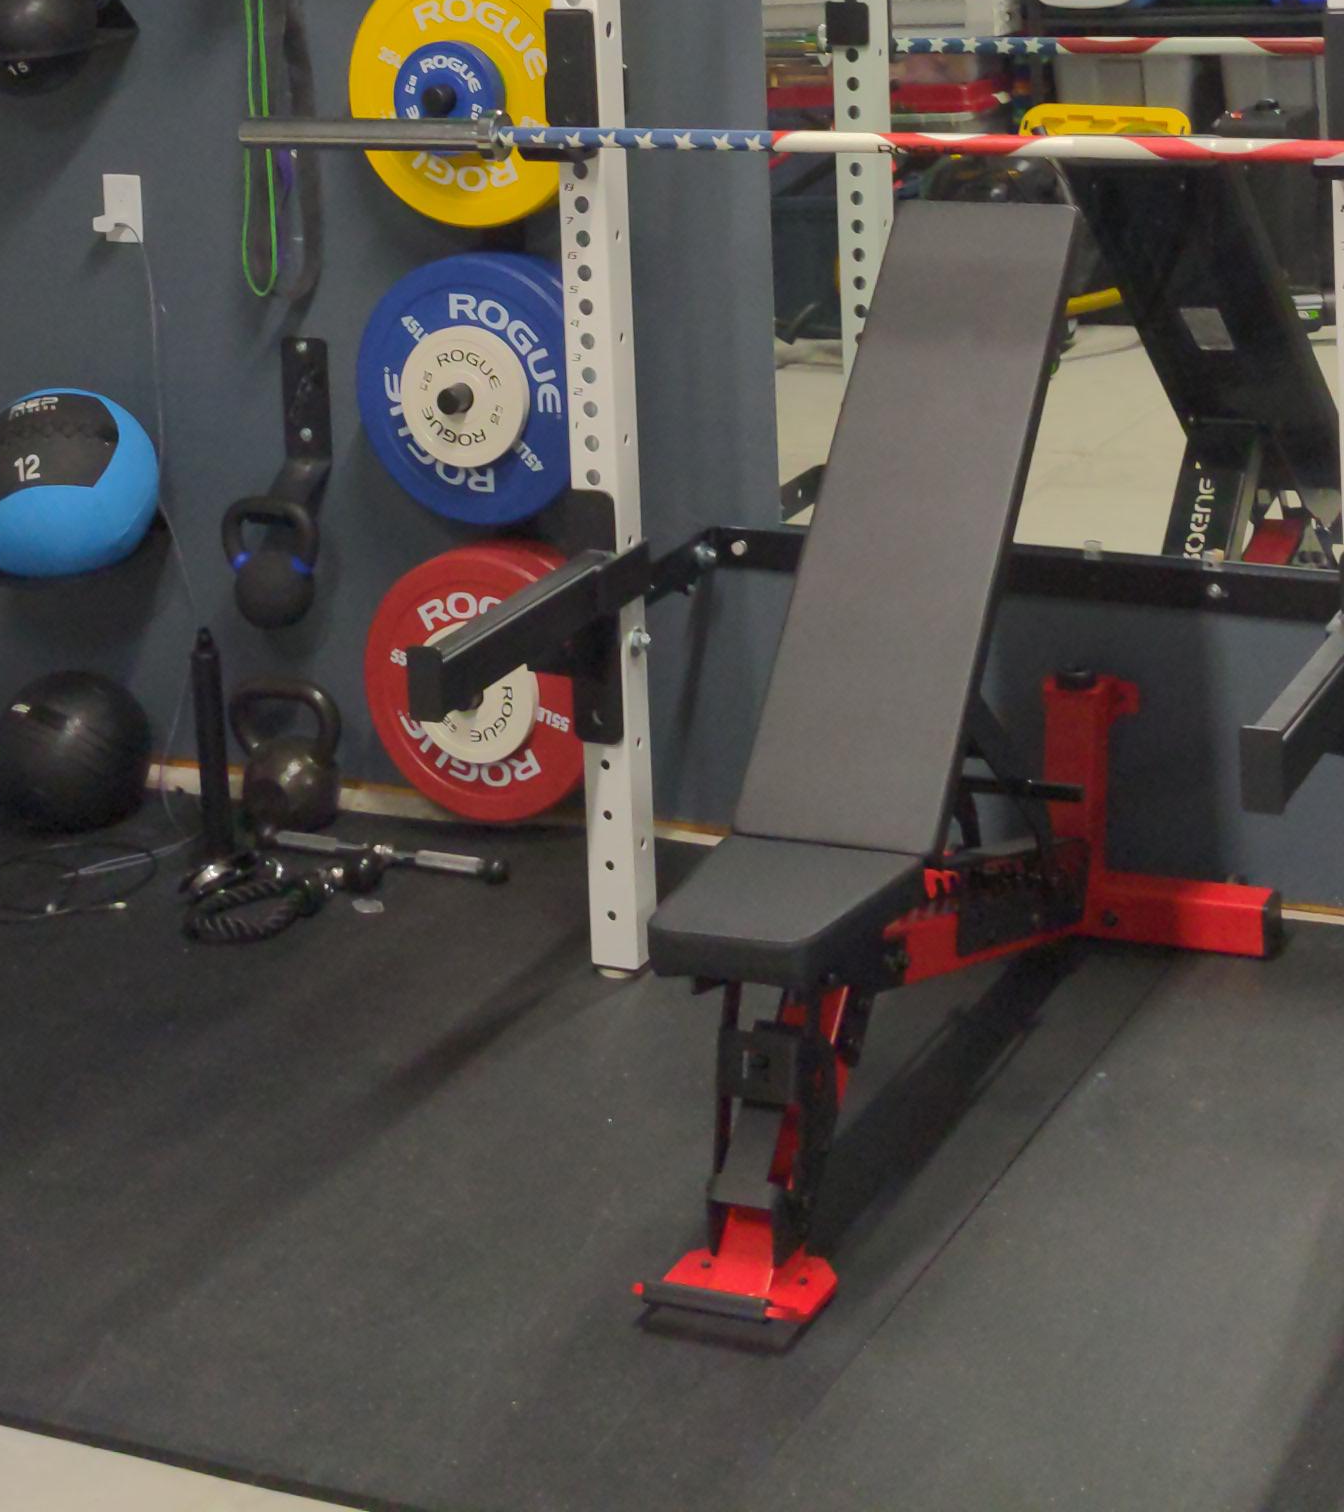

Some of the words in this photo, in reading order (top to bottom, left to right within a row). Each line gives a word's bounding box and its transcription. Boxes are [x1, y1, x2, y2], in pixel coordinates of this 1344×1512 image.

[7, 61, 30, 76] 15
[419, 55, 482, 94] ROGUE
[412, 152, 520, 192] ROG
[436, 349, 503, 392] ROGUE
[449, 293, 562, 414] ROGUE
[422, 405, 487, 446] ROGUE
[13, 454, 41, 482] 12
[470, 686, 513, 743] ROGUE
